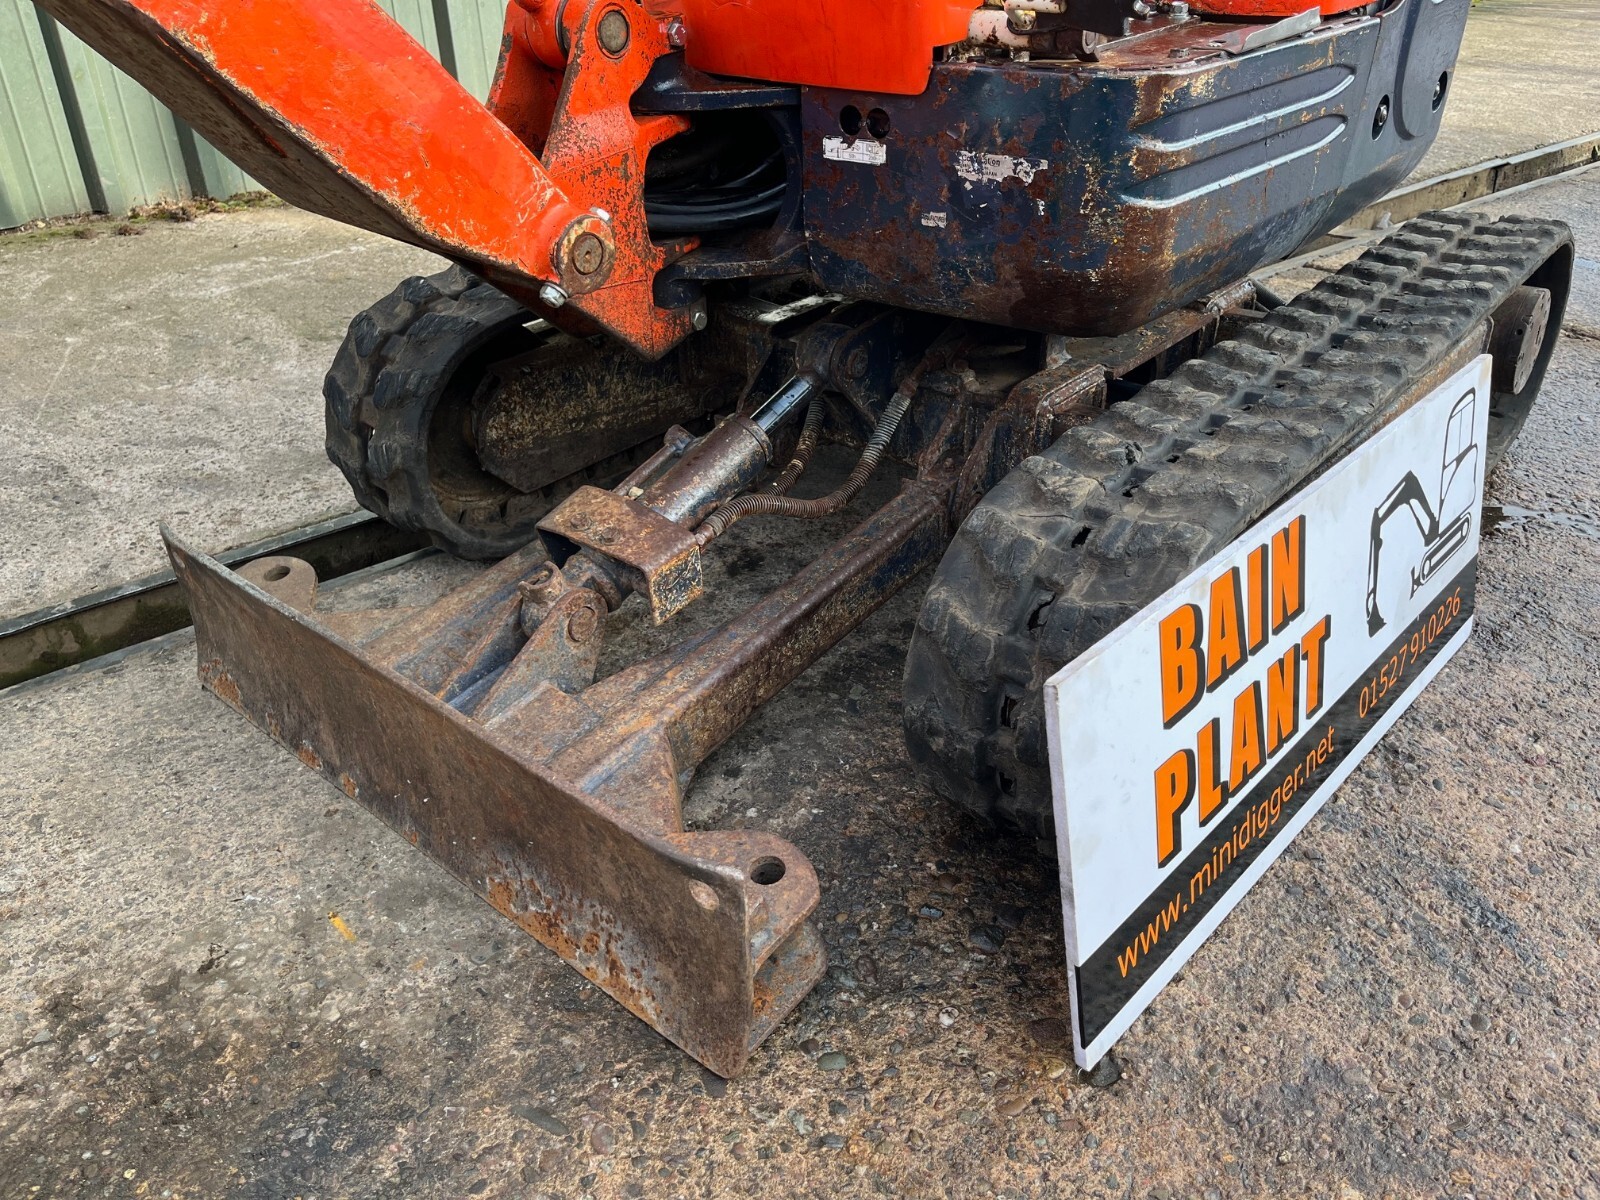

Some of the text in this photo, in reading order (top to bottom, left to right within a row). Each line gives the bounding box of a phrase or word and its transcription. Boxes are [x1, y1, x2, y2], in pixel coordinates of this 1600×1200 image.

[1154, 615, 1331, 868] PLANT
[1159, 514, 1305, 729] BAIN
[1116, 727, 1335, 978] www.minidigger.net
